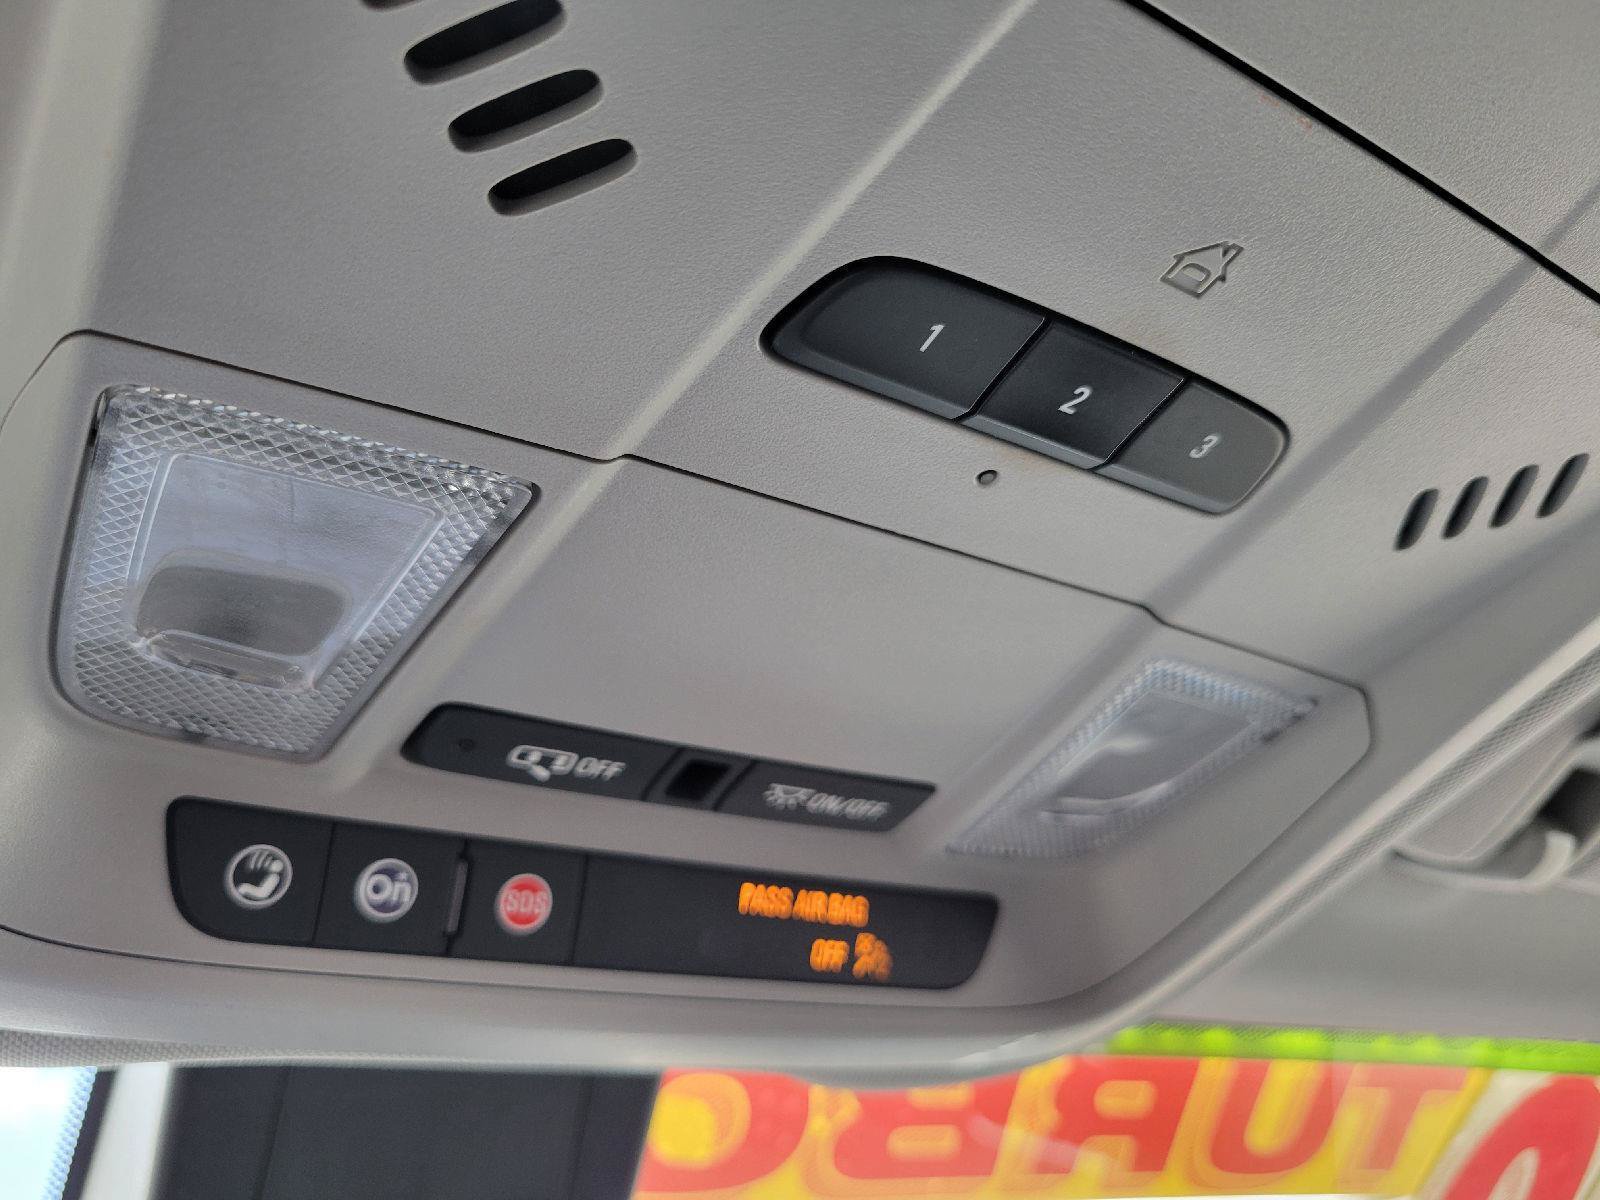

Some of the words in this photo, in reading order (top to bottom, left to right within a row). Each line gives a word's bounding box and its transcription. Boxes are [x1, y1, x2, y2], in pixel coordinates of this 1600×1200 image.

[918, 323, 944, 353] 1
[1058, 386, 1093, 415] 2
[1188, 434, 1220, 459] 3
[574, 756, 626, 780] OFF
[505, 889, 548, 916] SOS
[738, 882, 794, 919] PASS
[810, 938, 849, 973] OFF
